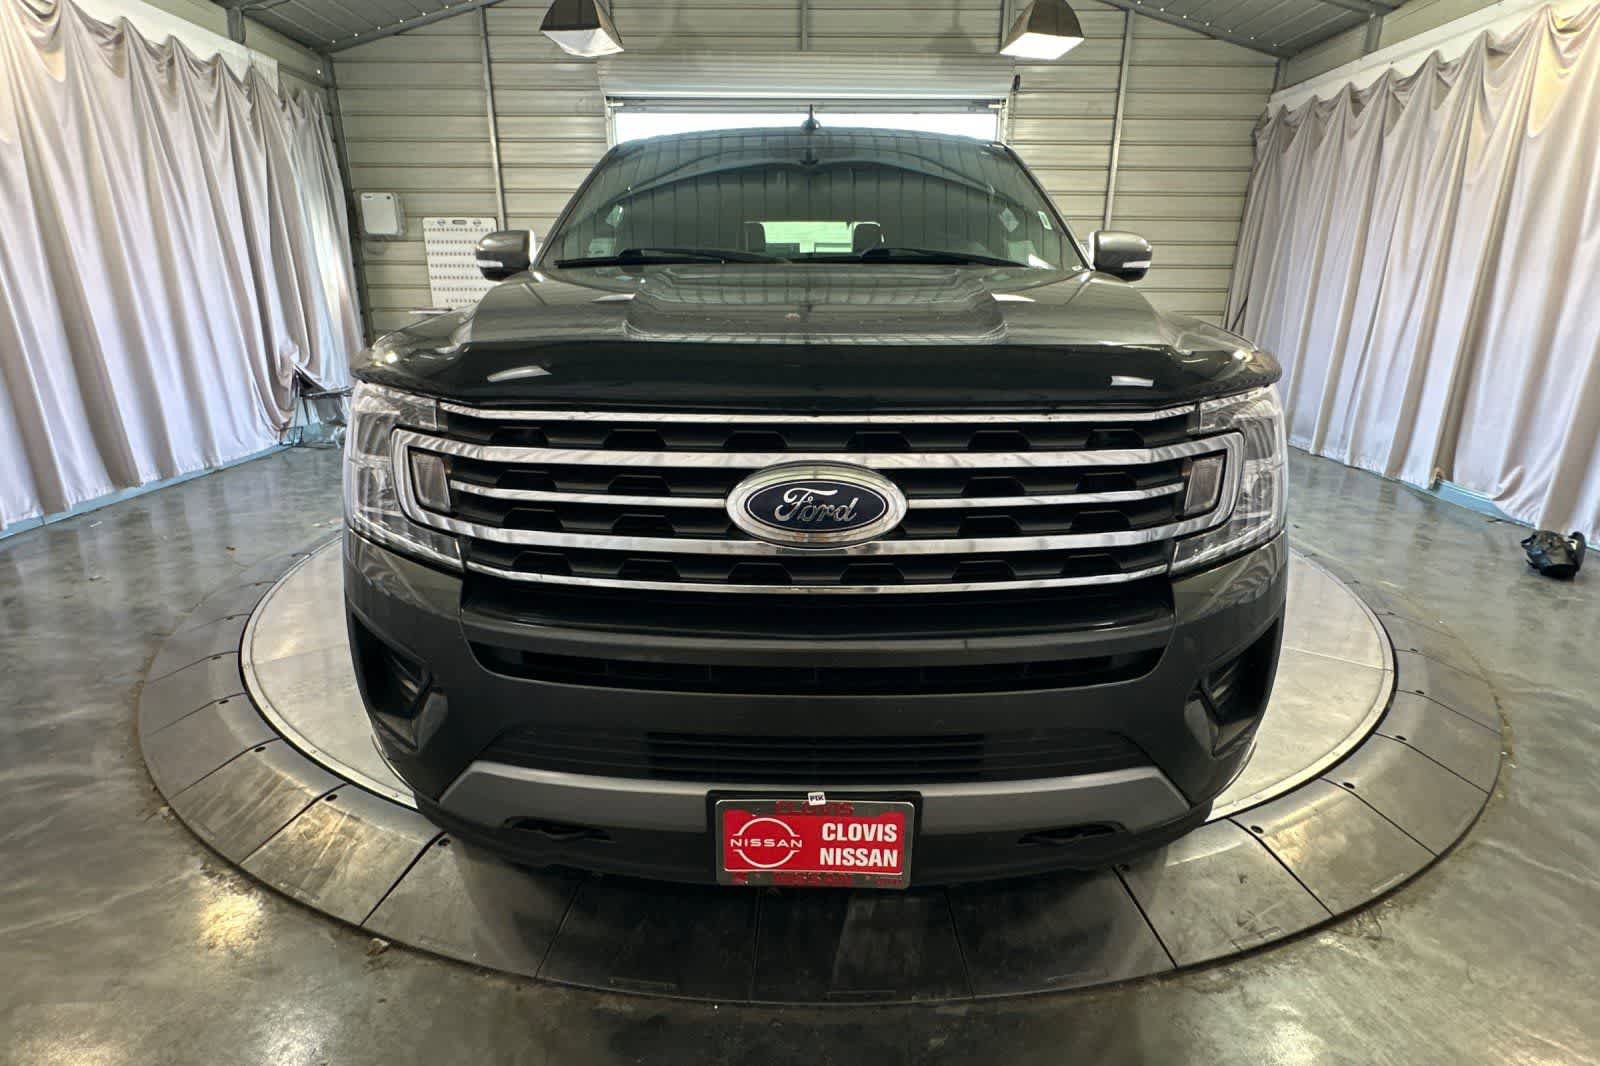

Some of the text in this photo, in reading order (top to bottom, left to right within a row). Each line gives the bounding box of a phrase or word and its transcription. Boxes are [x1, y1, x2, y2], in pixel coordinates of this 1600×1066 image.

[774, 487, 859, 523] Ford
[822, 823, 897, 842] CLOVIS
[730, 838, 803, 848] NISSAN
[819, 848, 898, 868] NISSAN
